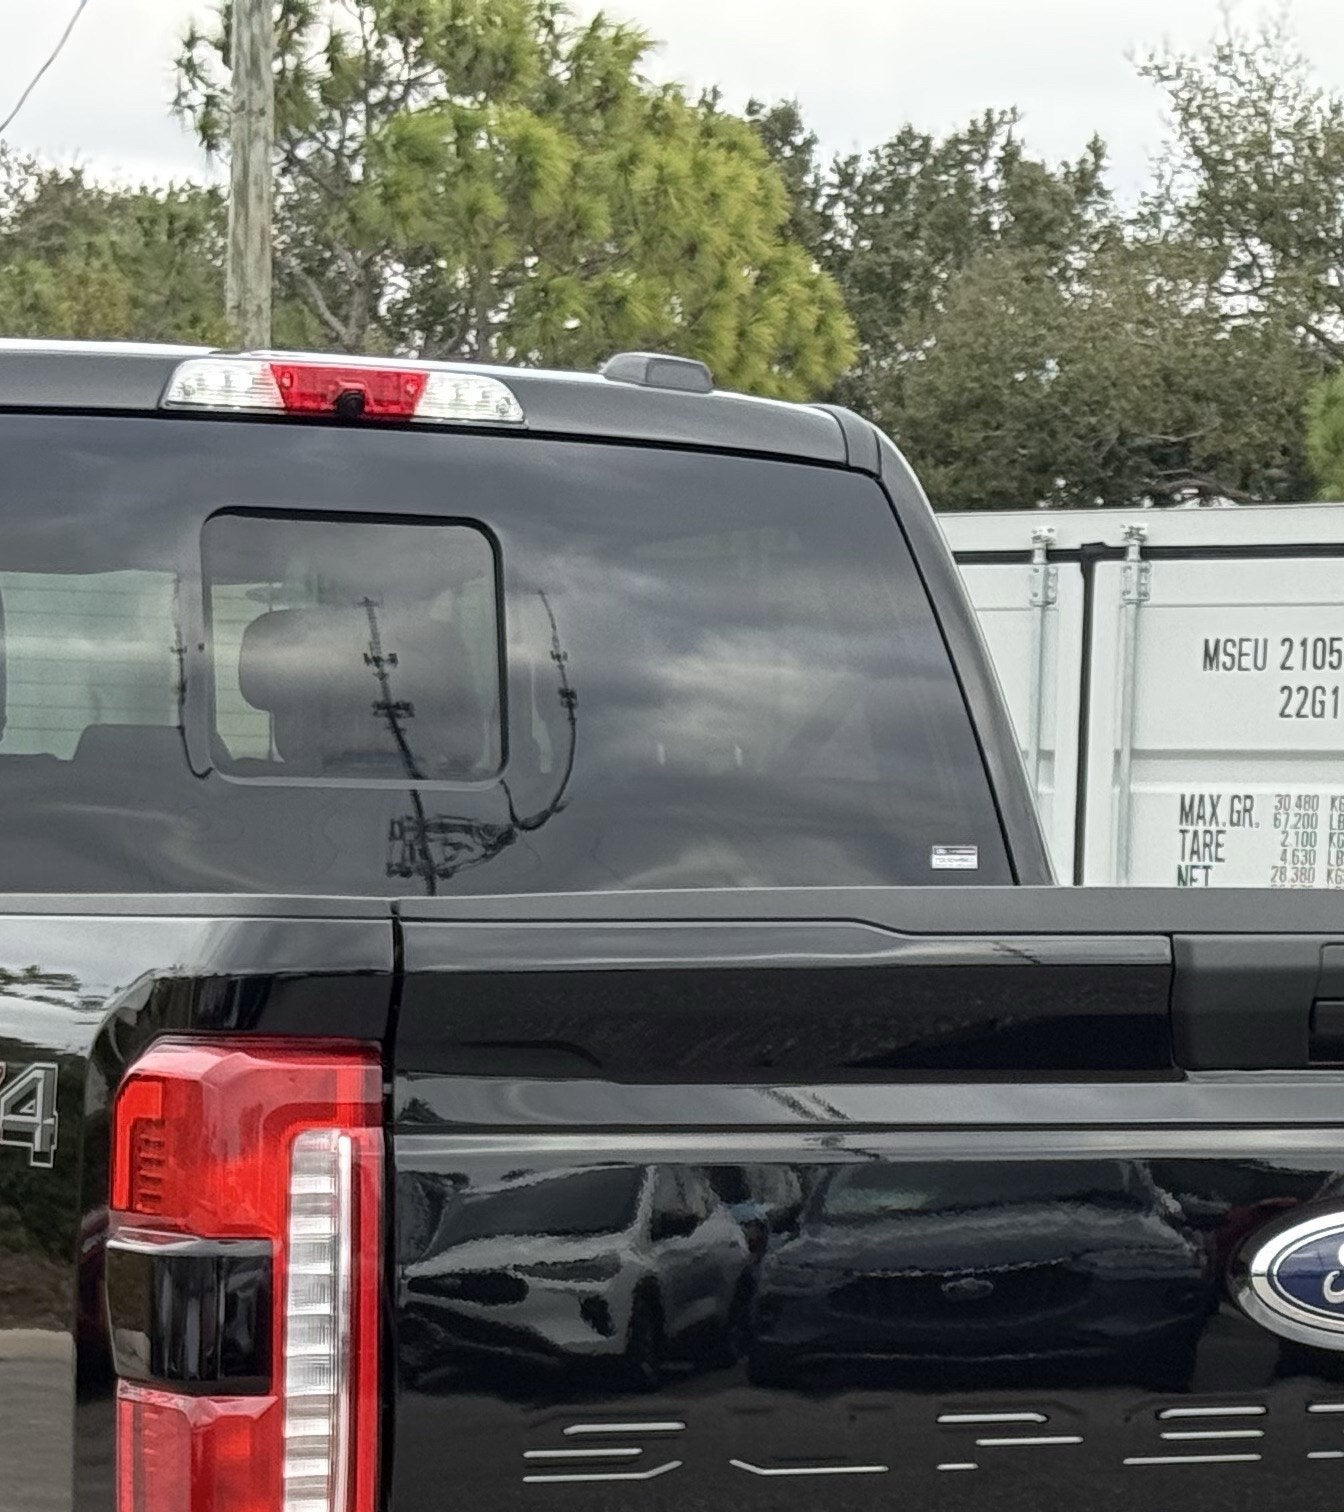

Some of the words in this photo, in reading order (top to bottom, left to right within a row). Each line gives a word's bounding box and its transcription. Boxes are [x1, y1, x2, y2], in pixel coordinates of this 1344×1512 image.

[1203, 637, 1269, 671] MSEU
[1279, 685, 1340, 719] 22G1
[1179, 794, 1260, 828] MAX.GR.
[1179, 829, 1226, 862] TARE
